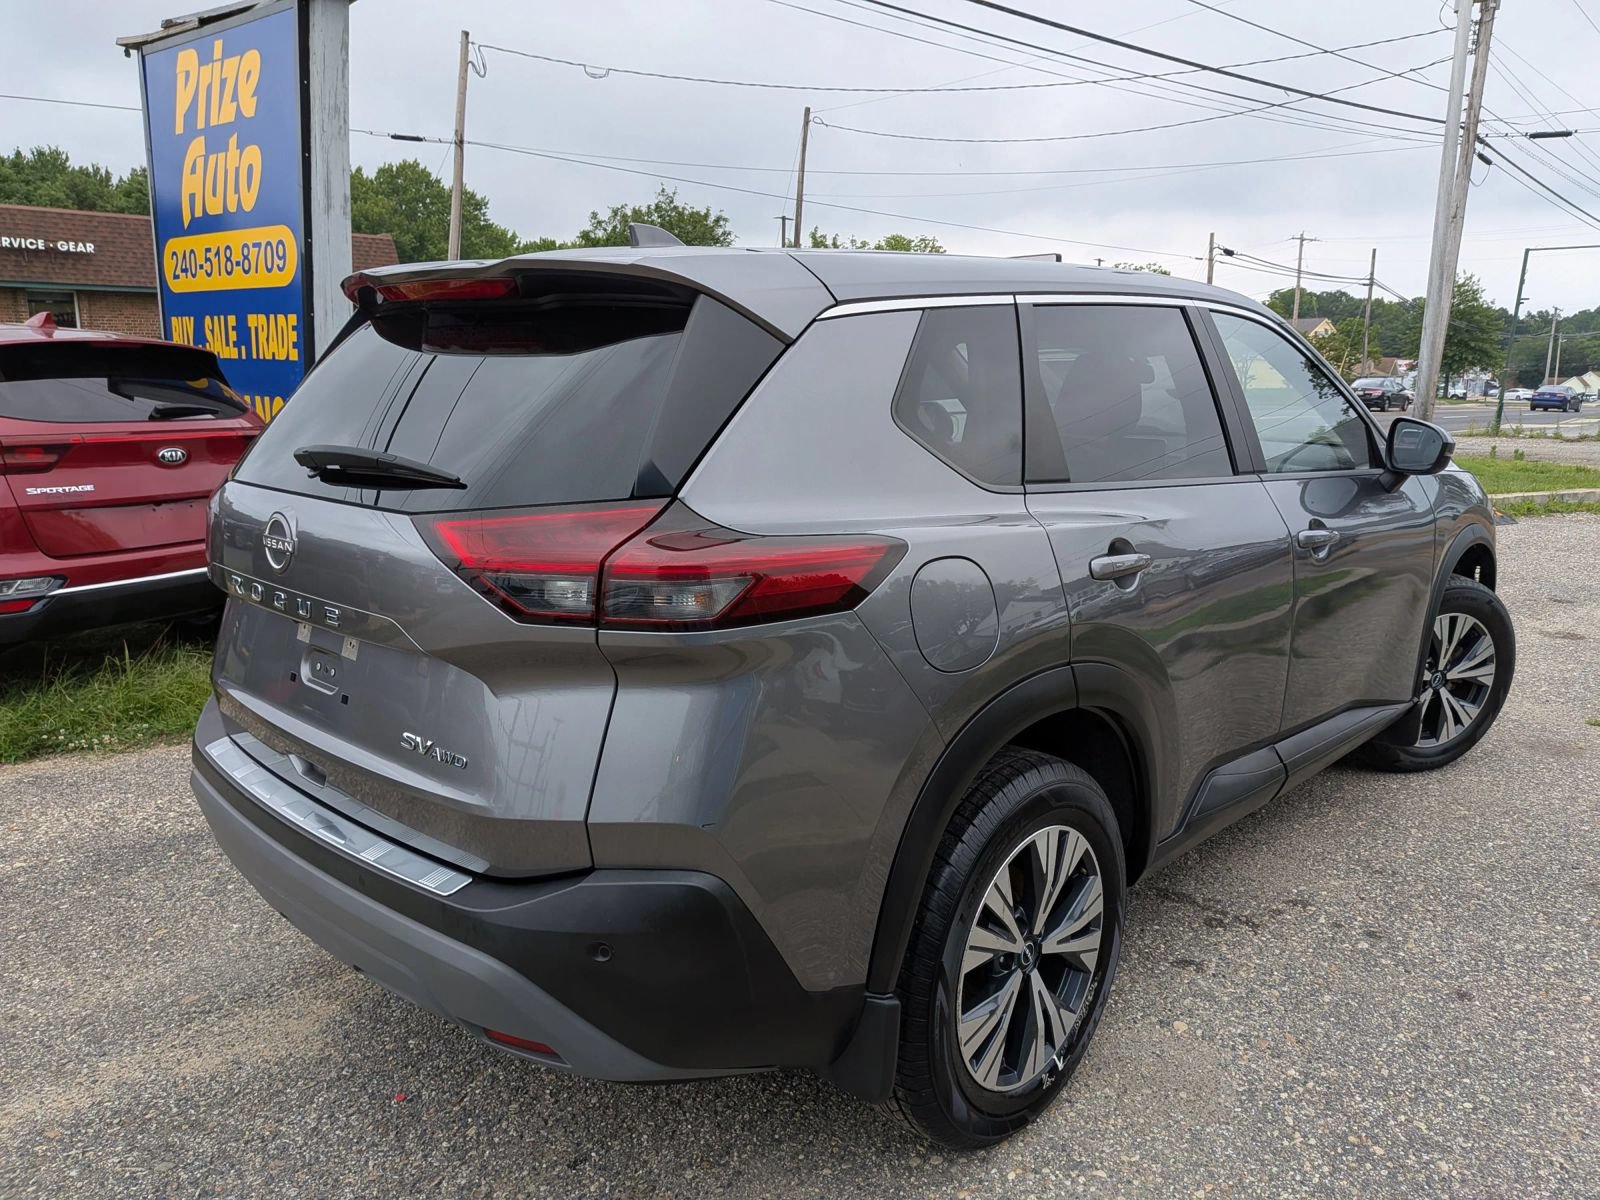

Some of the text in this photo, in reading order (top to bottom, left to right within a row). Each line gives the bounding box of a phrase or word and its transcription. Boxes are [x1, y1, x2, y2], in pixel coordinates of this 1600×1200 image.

[175, 39, 262, 135] Prize
[181, 133, 263, 230] Auto
[0, 236, 95, 254] RVICE GEAR
[170, 239, 287, 281] 240-518-8709
[171, 314, 299, 361] BUY SALE TRADE
[164, 450, 183, 463] KIA
[25, 484, 95, 495] SPORTAGE
[231, 575, 341, 627] ROGUE
[401, 732, 468, 768] SV AWD
